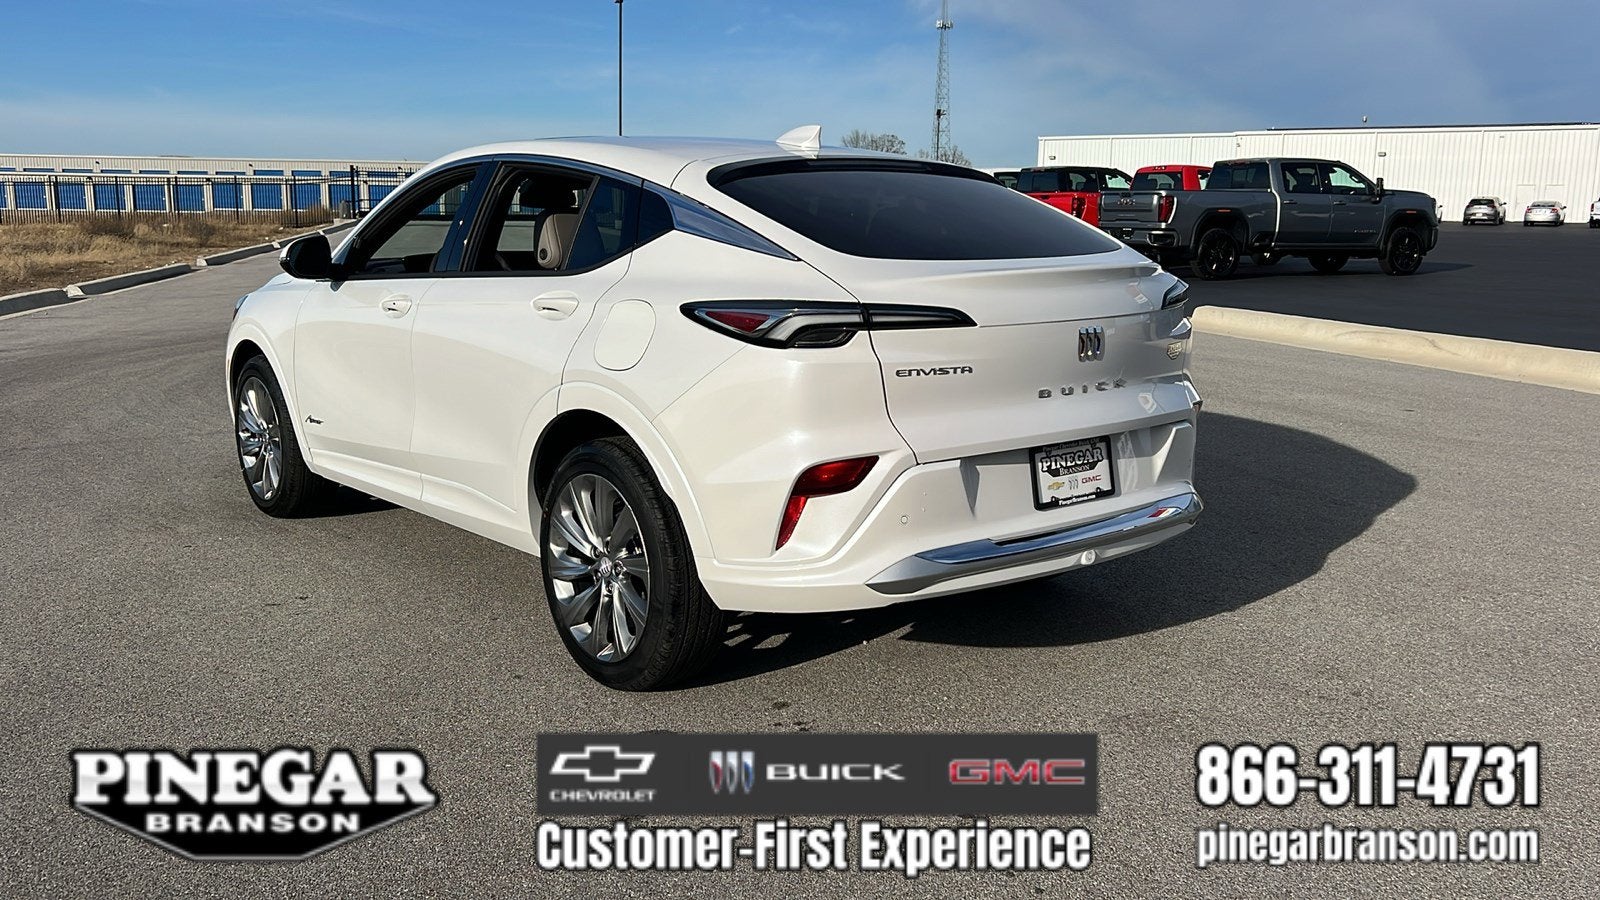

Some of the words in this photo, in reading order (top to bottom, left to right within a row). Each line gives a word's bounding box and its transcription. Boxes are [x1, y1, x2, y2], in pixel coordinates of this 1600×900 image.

[895, 366, 973, 378] ENVISTA
[1038, 379, 1127, 399] BUICK
[1041, 449, 1103, 471] PINEGAR
[1081, 475, 1102, 484] GMC
